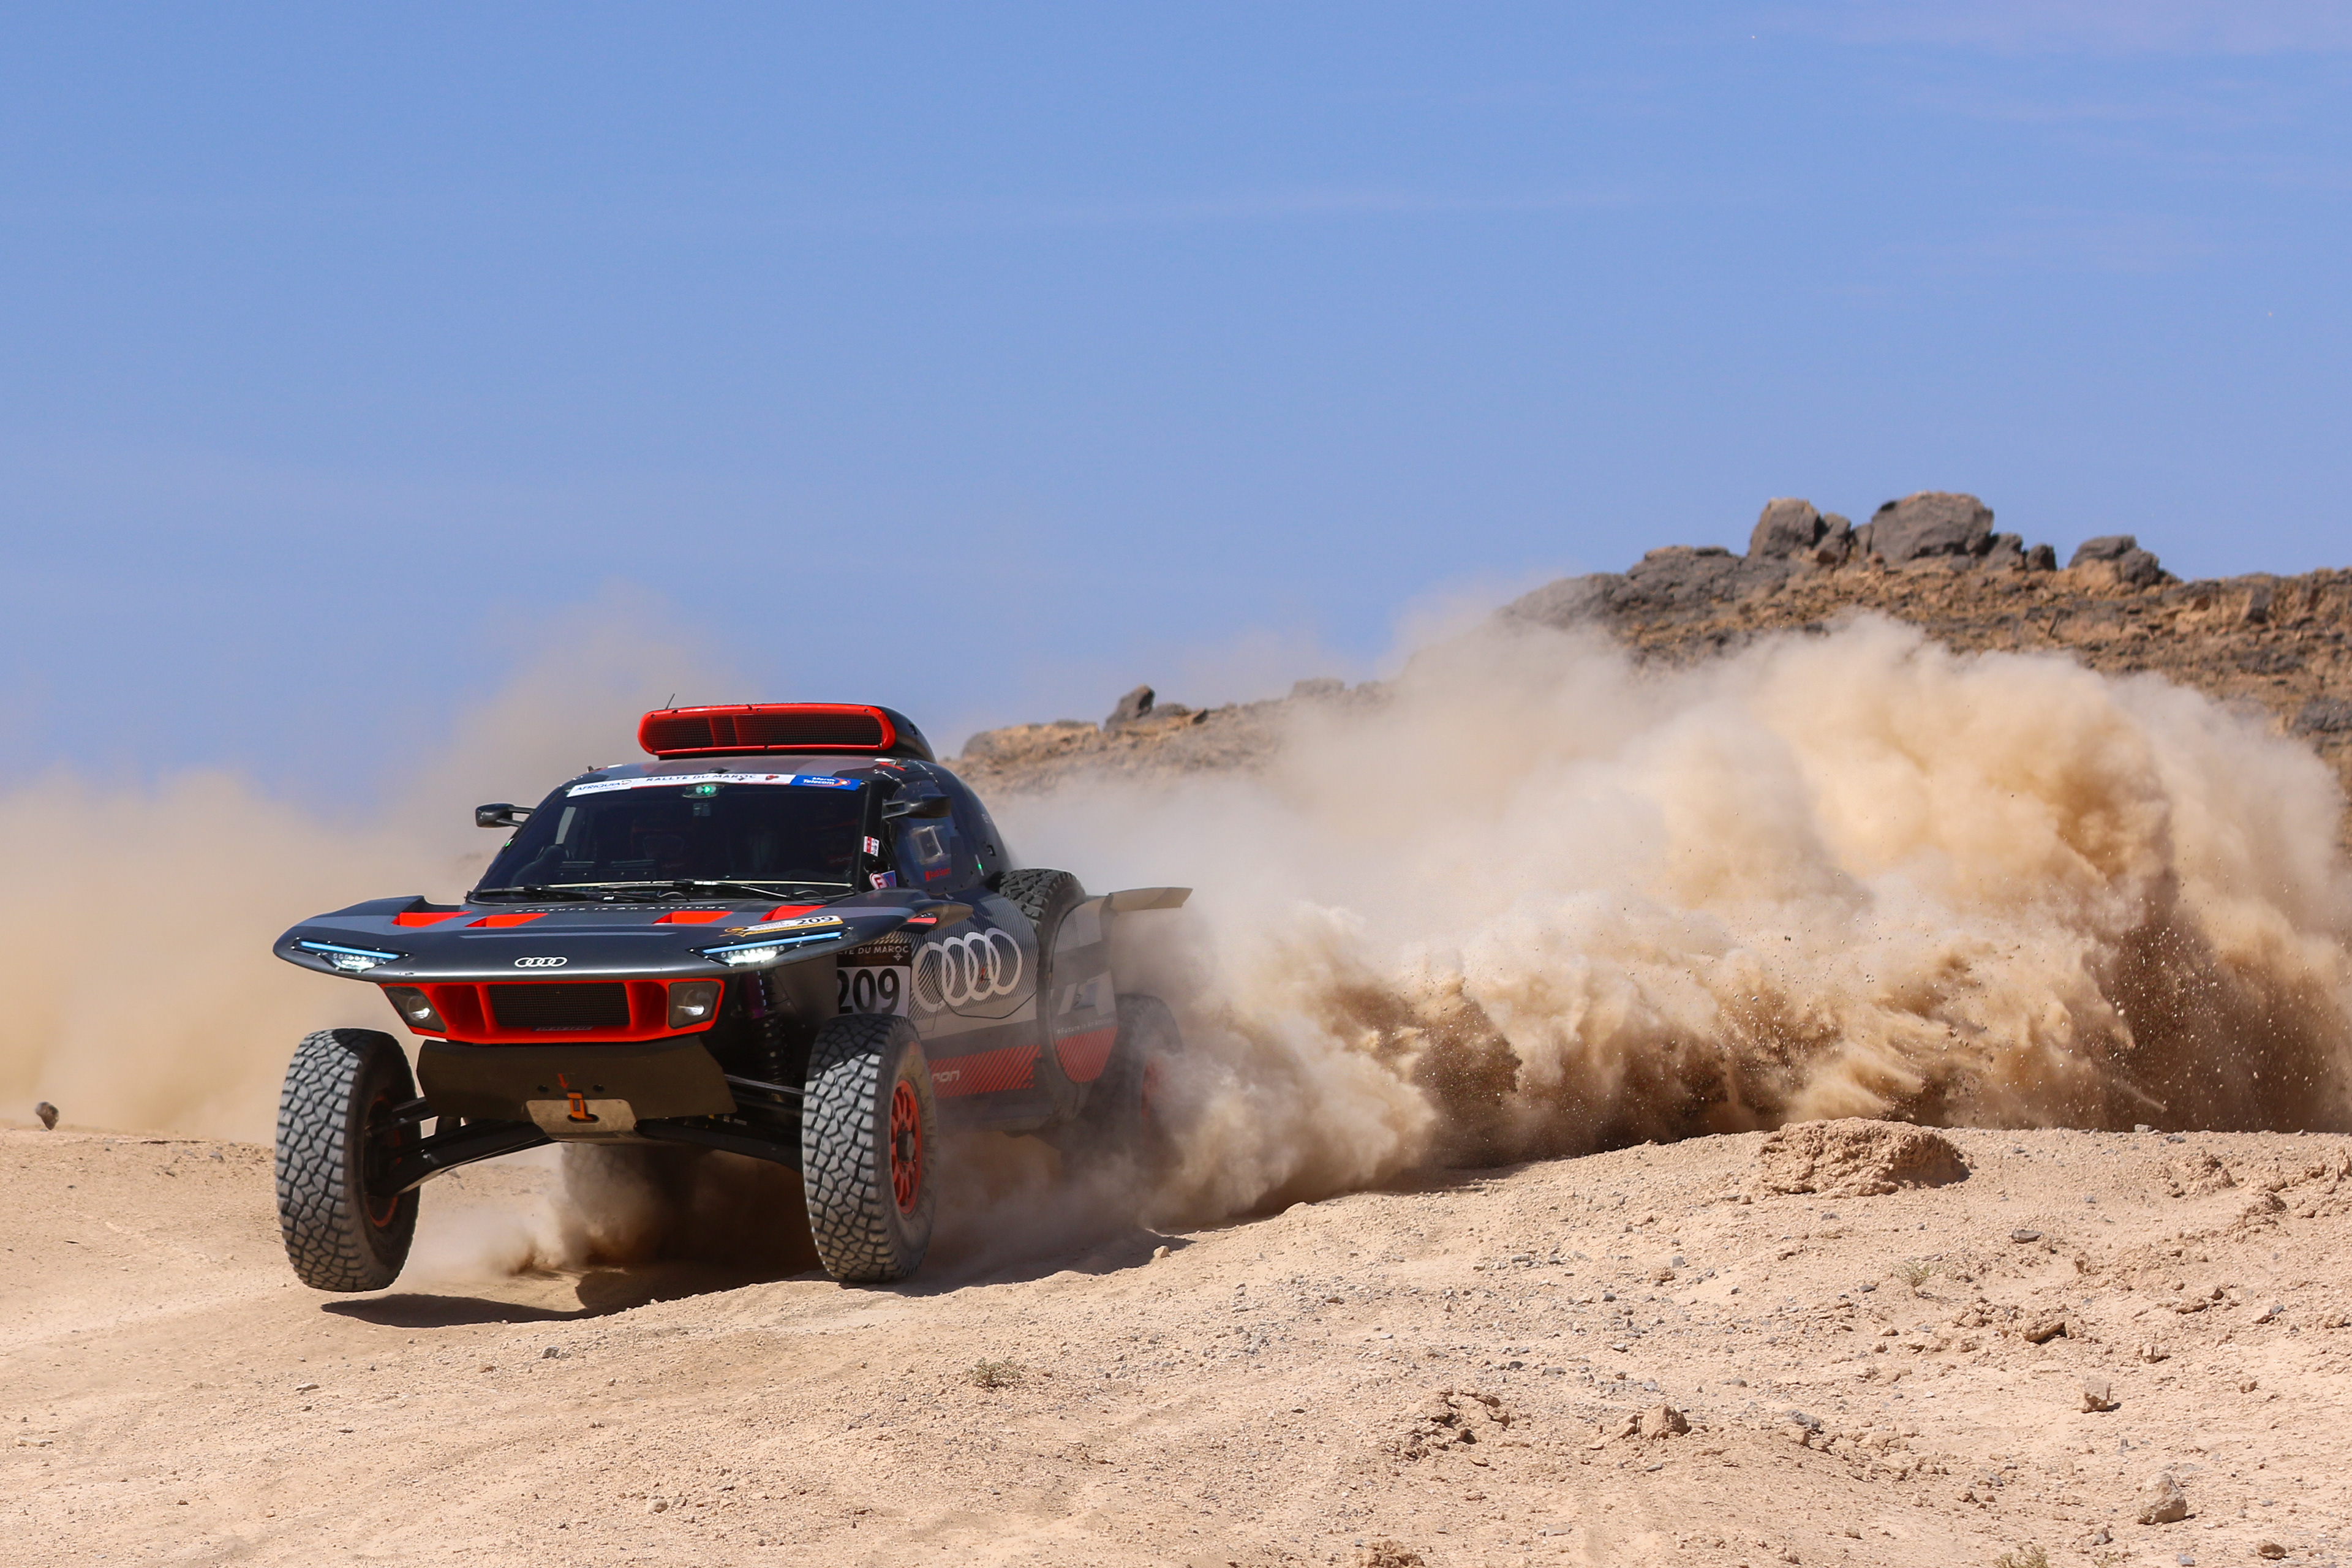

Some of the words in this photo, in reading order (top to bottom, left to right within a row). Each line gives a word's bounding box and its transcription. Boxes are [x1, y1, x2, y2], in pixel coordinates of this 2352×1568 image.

[576, 782, 620, 791] AFRIQUIA
[796, 916, 833, 925] 209
[837, 968, 900, 1016] 209
